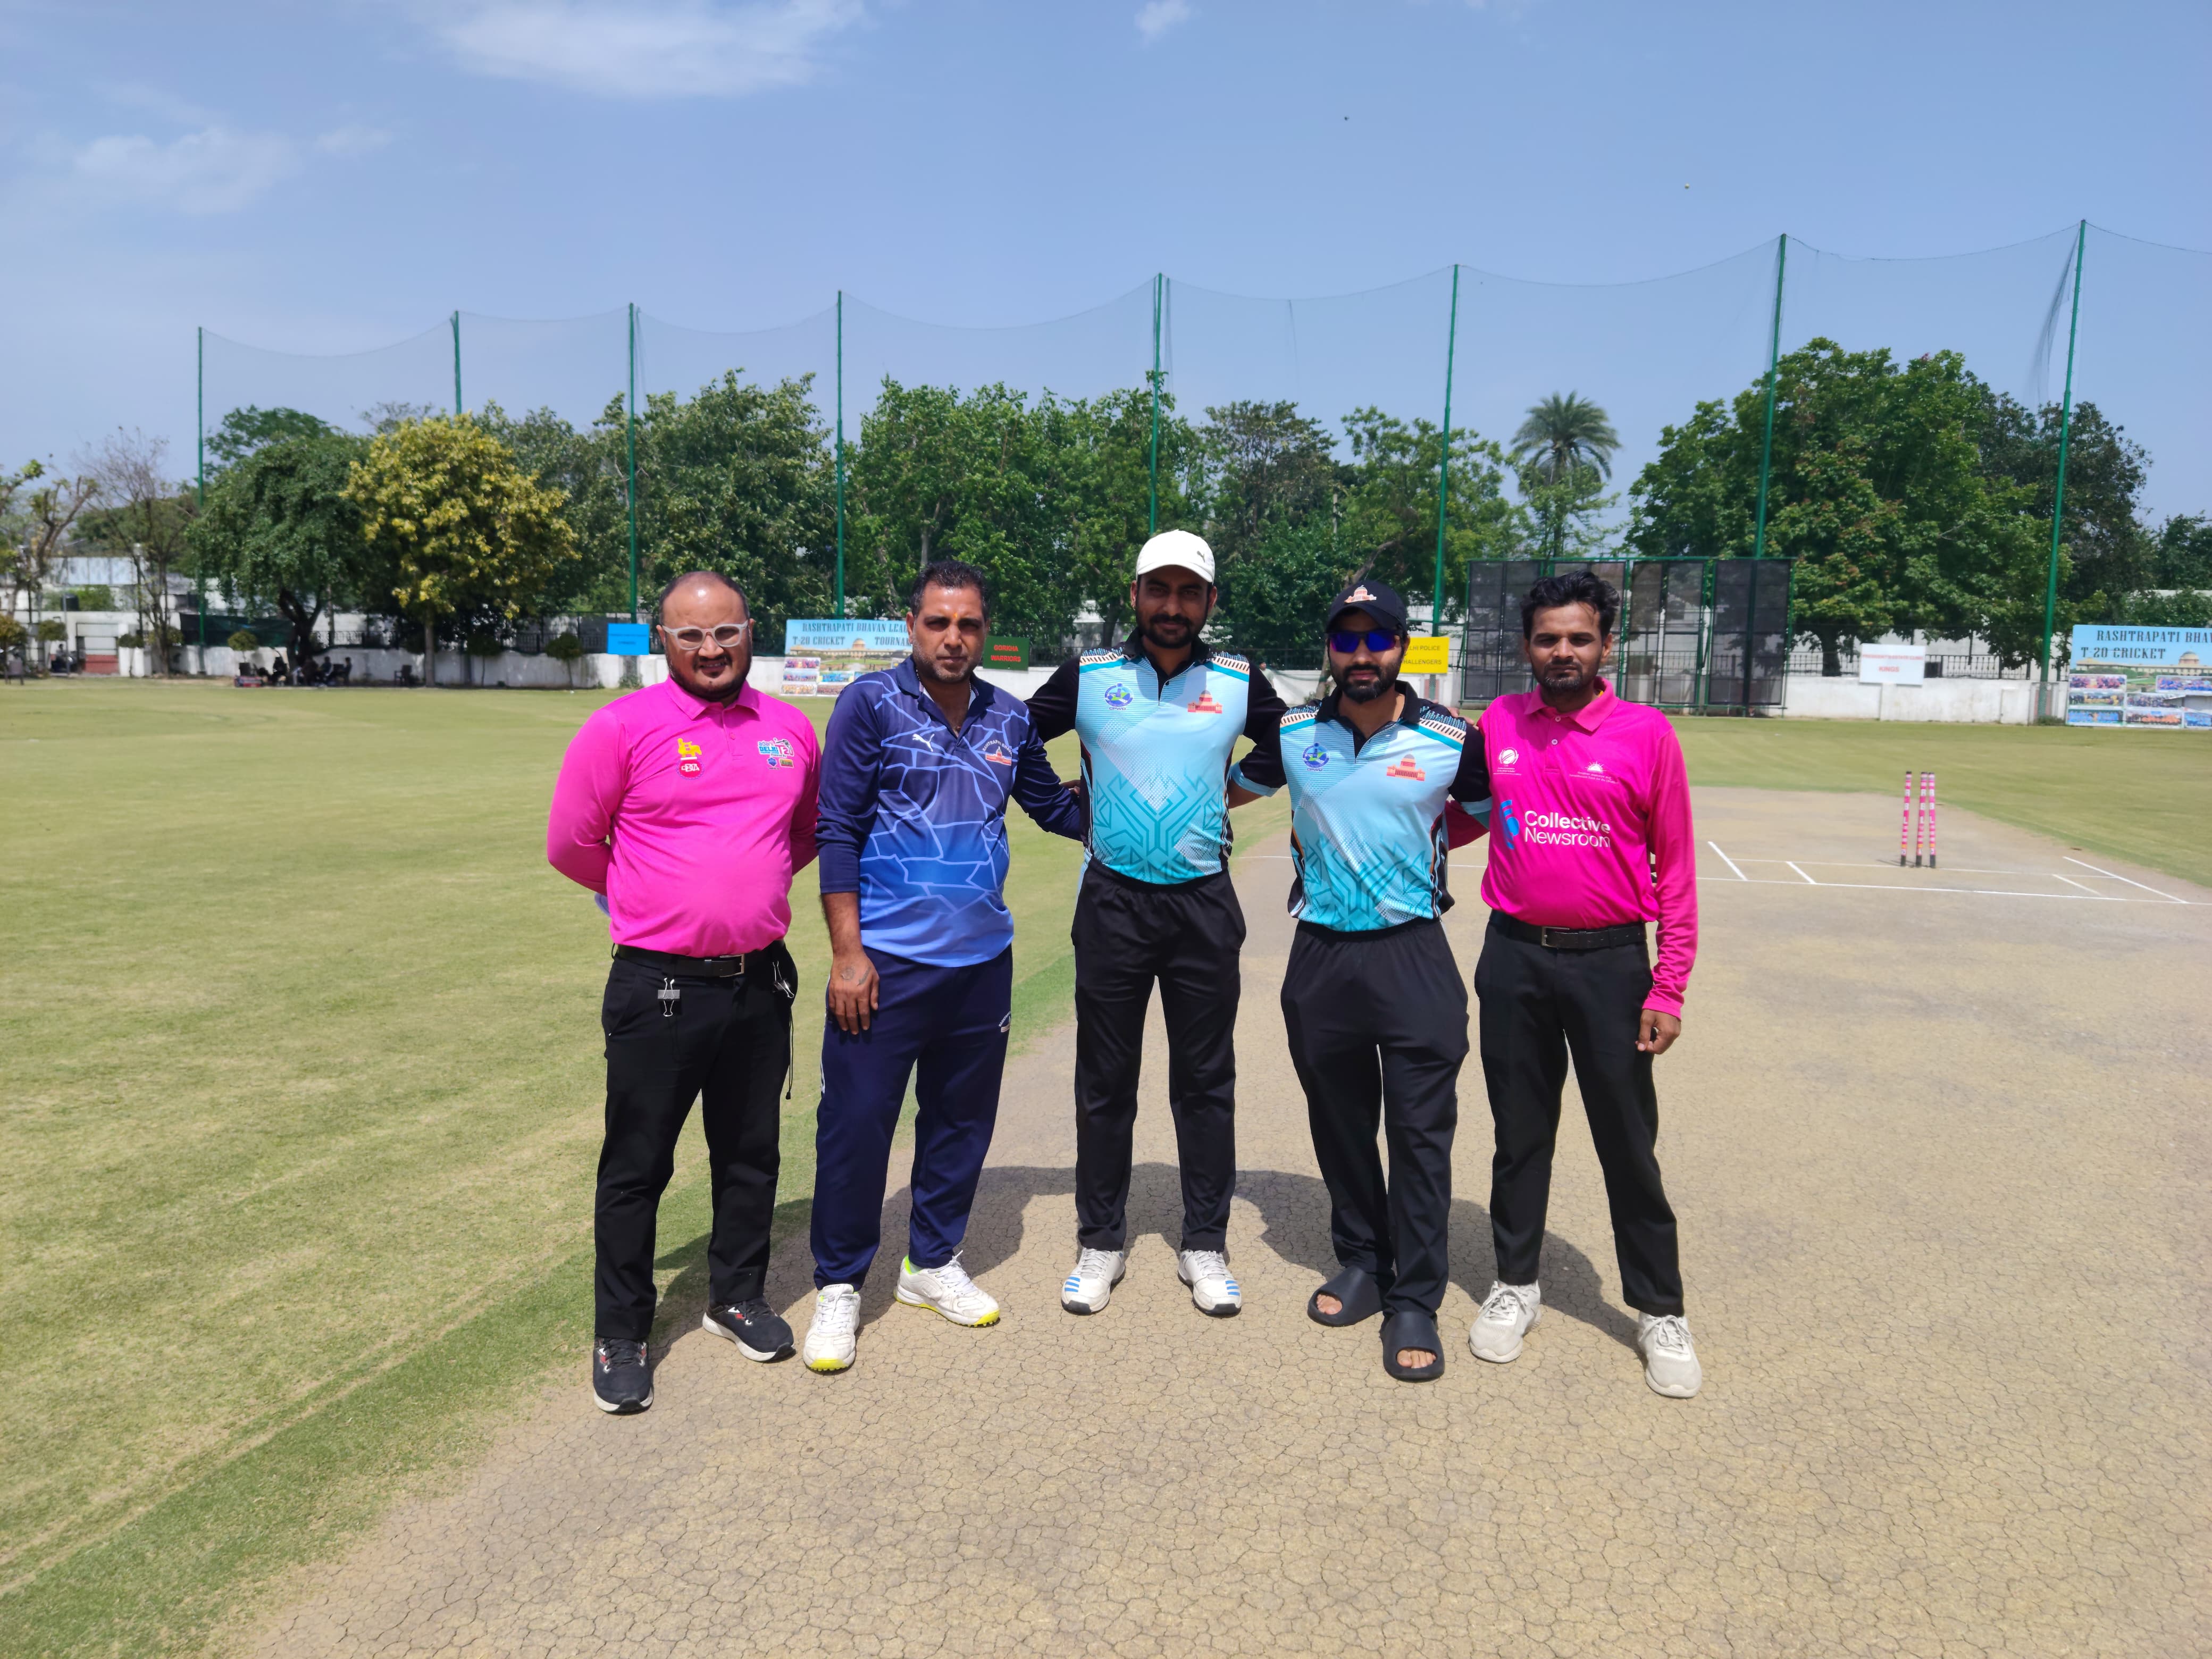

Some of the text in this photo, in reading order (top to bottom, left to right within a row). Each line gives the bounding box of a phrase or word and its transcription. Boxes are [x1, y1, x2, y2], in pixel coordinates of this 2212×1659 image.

[802, 623, 853, 632] RASHTRAPATI
[857, 623, 885, 632] BHAVAN
[813, 636, 845, 646] CRICKET
[2097, 630, 2180, 642] RASHTRAPATI
[2113, 648, 2165, 659] CRICKET
[1524, 810, 1610, 834] Collective
[1524, 826, 1610, 847] Newsroom
